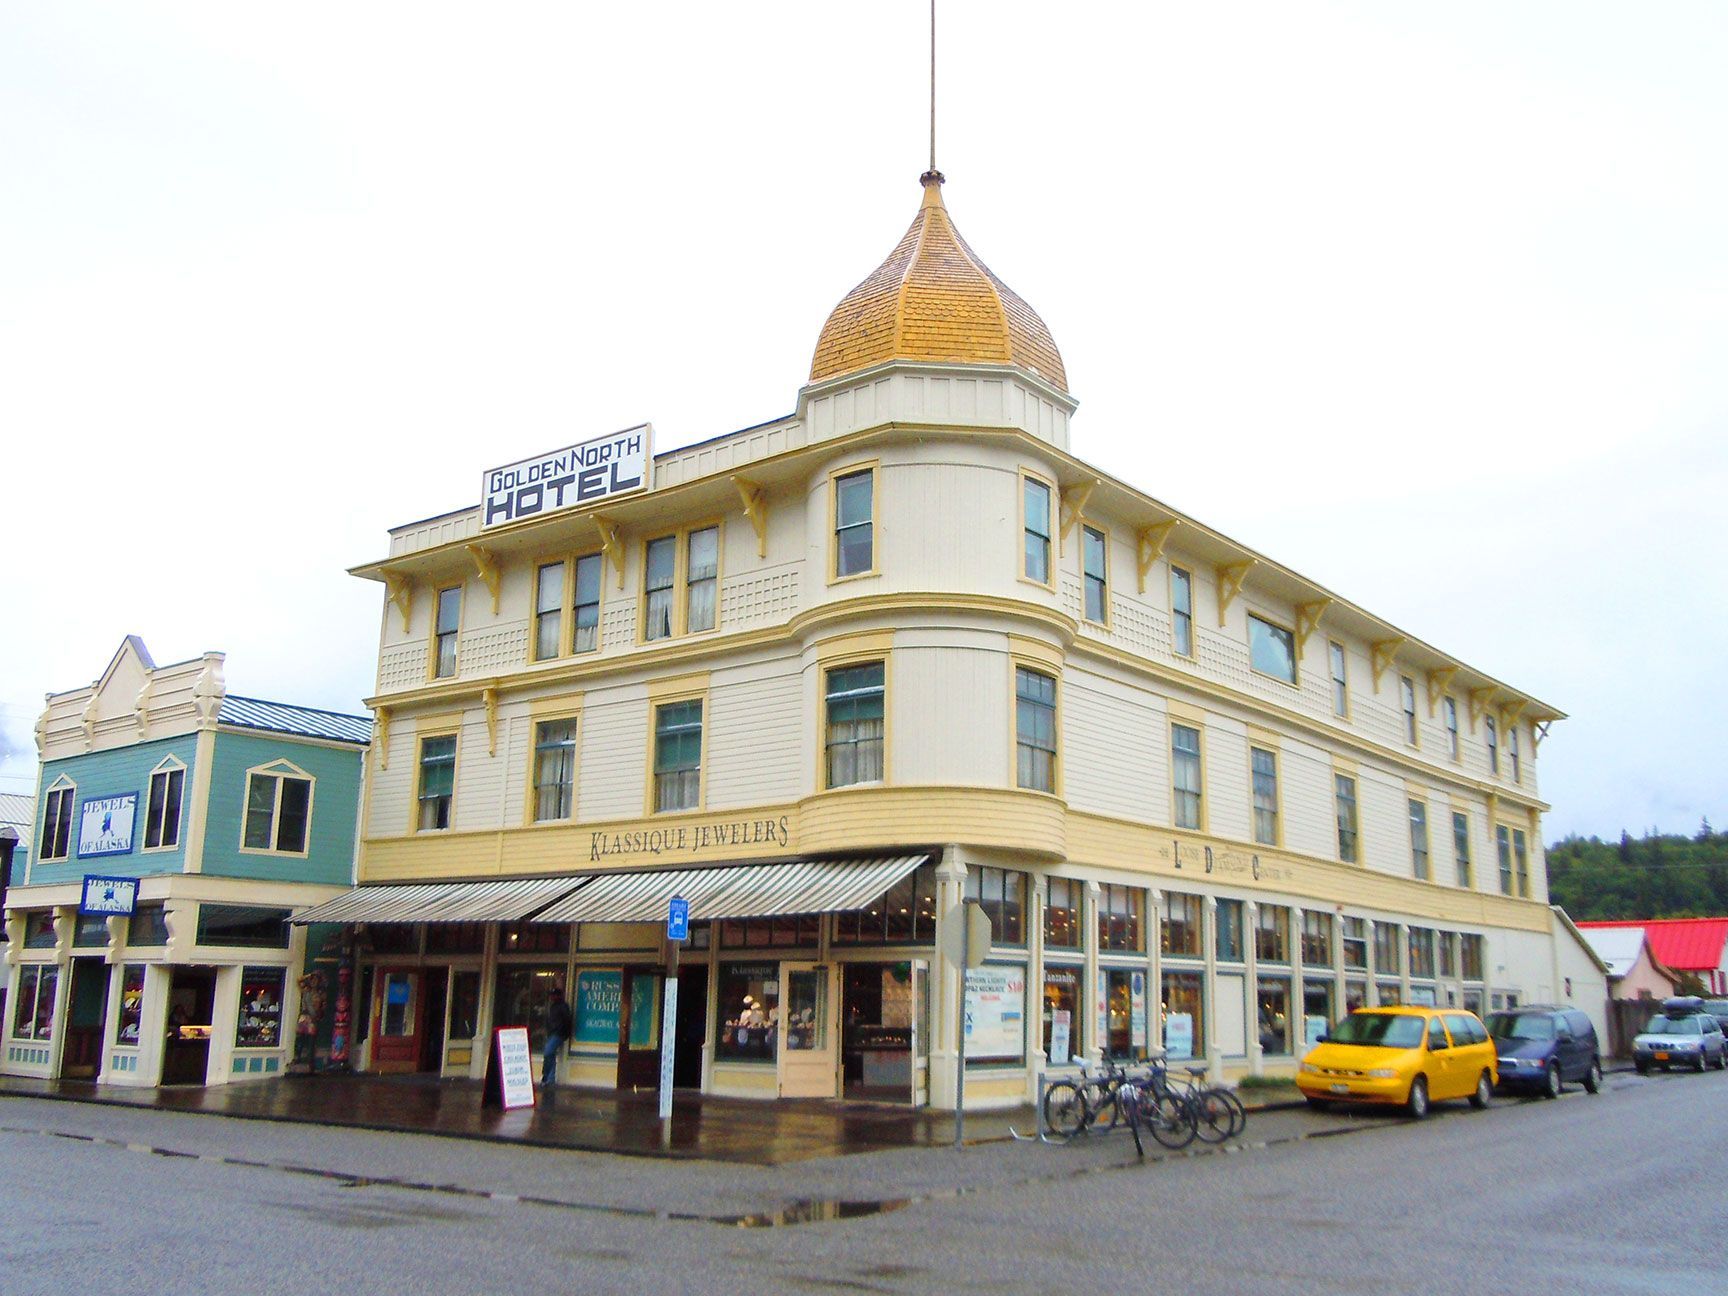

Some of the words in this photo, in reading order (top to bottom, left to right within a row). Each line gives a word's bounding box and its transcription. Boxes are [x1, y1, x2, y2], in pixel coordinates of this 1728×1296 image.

[490, 457, 566, 494] GOLDEN
[570, 435, 641, 471] NORTH
[486, 462, 641, 526] HOTEL
[84, 798, 135, 814] JEWELS
[80, 841, 92, 852] OF
[95, 838, 129, 851] ALASKA
[590, 828, 686, 861] KLASSIQUE
[693, 816, 788, 851] JEWELERS
